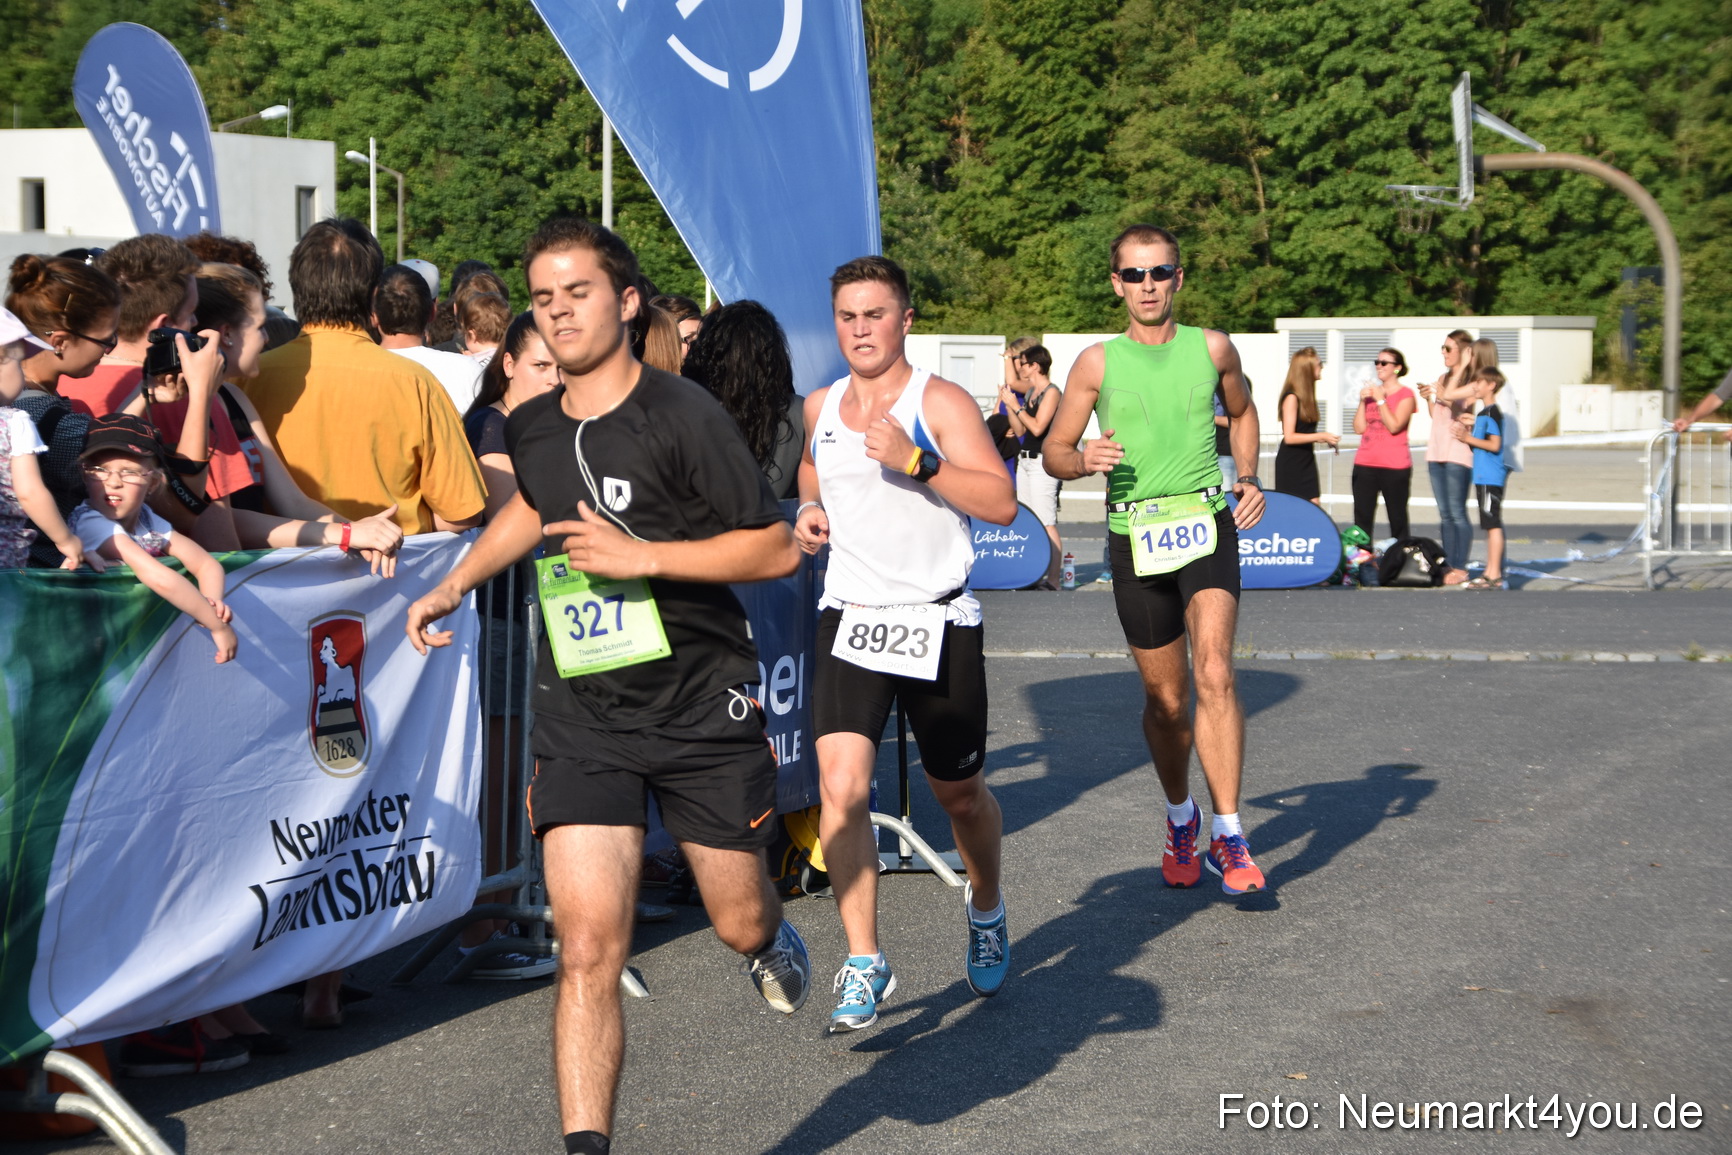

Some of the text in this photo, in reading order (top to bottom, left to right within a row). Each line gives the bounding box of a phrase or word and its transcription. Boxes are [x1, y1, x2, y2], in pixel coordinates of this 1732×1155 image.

[172, 479, 198, 507] SONY
[974, 529, 1029, 543] Lächeln
[1141, 522, 1208, 553] 1480
[1238, 533, 1320, 554] scher
[993, 545, 1025, 558] mit!
[564, 593, 625, 641] 327
[578, 648, 602, 657] Thomas
[602, 640, 633, 652] Schmidt
[848, 623, 930, 659] 8923
[325, 737, 356, 761] 1628
[767, 729, 801, 766] ILE
